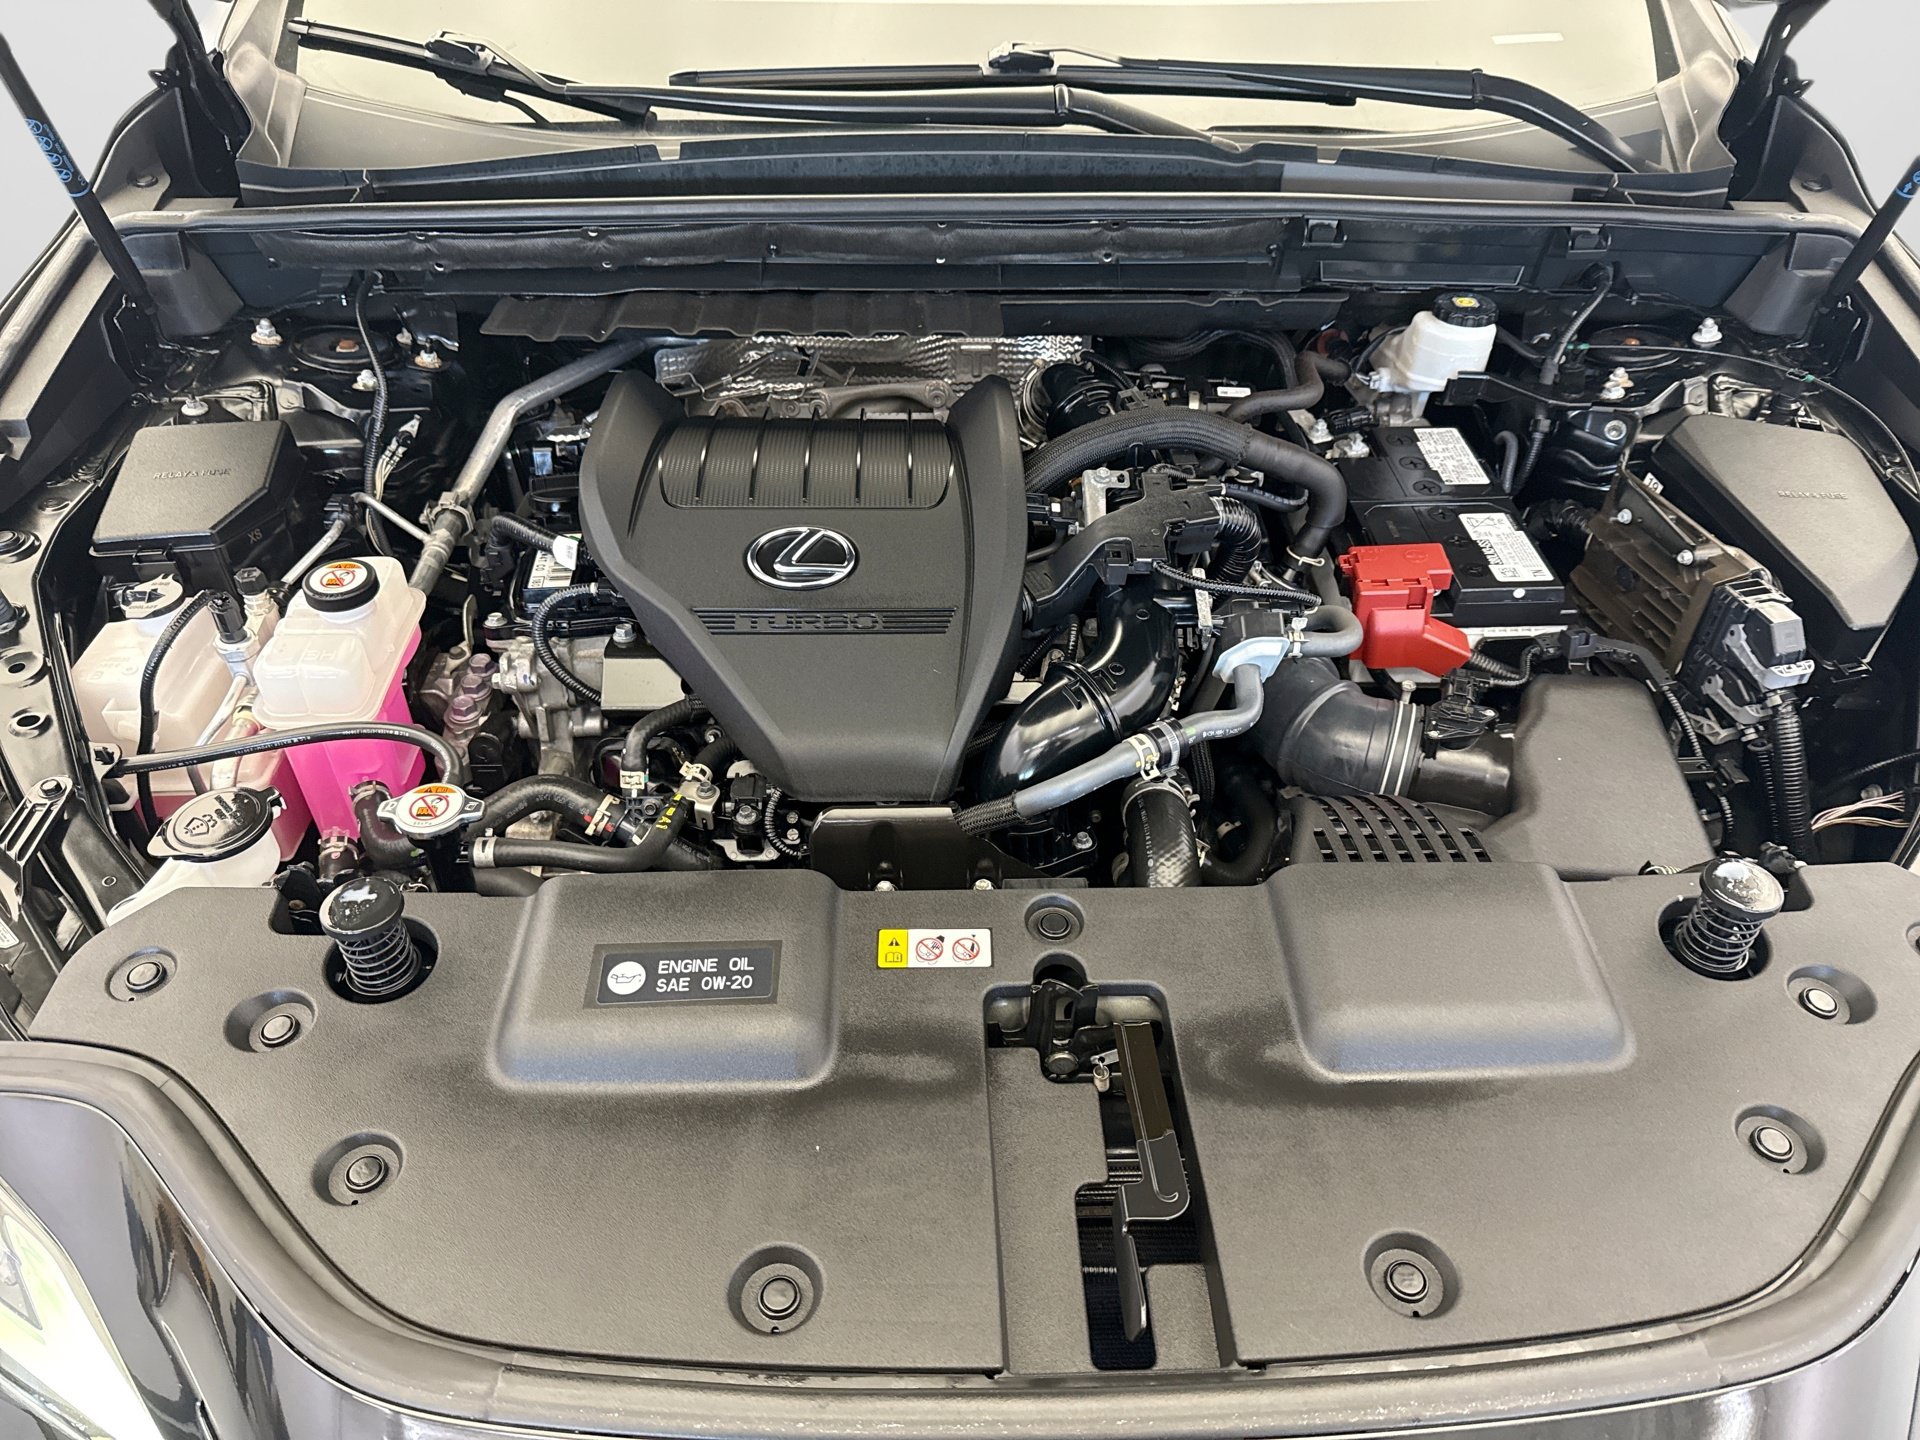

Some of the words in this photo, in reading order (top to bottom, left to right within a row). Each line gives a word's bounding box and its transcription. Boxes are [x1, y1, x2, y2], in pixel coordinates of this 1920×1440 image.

[737, 612, 880, 631] TURBO
[657, 957, 719, 975] ENGINE
[728, 956, 755, 972] OIL
[655, 977, 691, 993] SAE
[700, 974, 753, 991] 0W-20
